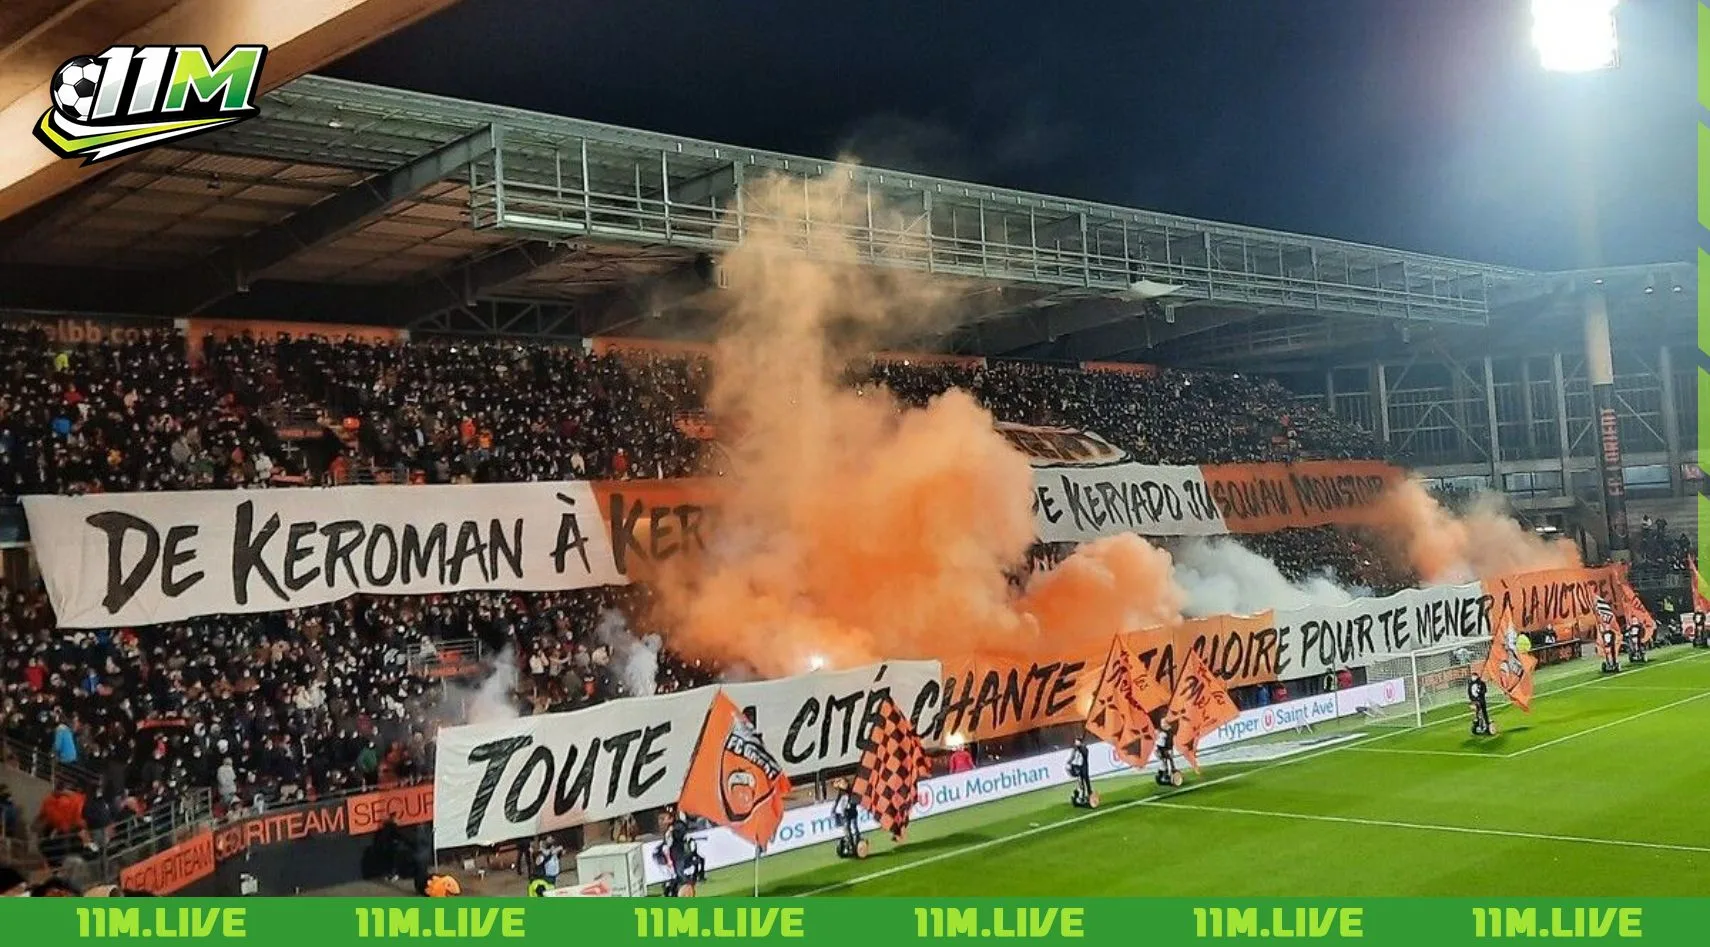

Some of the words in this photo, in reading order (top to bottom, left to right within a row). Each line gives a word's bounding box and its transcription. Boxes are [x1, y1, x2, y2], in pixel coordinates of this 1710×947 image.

[86, 511, 204, 614] DE
[233, 500, 523, 605] KEROMAN
[549, 492, 591, 575] À
[610, 493, 708, 575] KER
[1060, 474, 1184, 531] KERYADO
[466, 721, 672, 838] TOUTE
[782, 665, 892, 764] CITÉ
[911, 661, 1086, 741] CHANTE
[1301, 613, 1375, 668] POUR
[1379, 606, 1411, 651] TE
[1415, 594, 1495, 645] MENER
[1218, 717, 1259, 740] Hyper
[1276, 703, 1309, 725] Saint
[1311, 697, 1334, 718] Avé
[936, 785, 960, 804] du
[966, 766, 1049, 798] Morbihan
[769, 821, 805, 842] os
